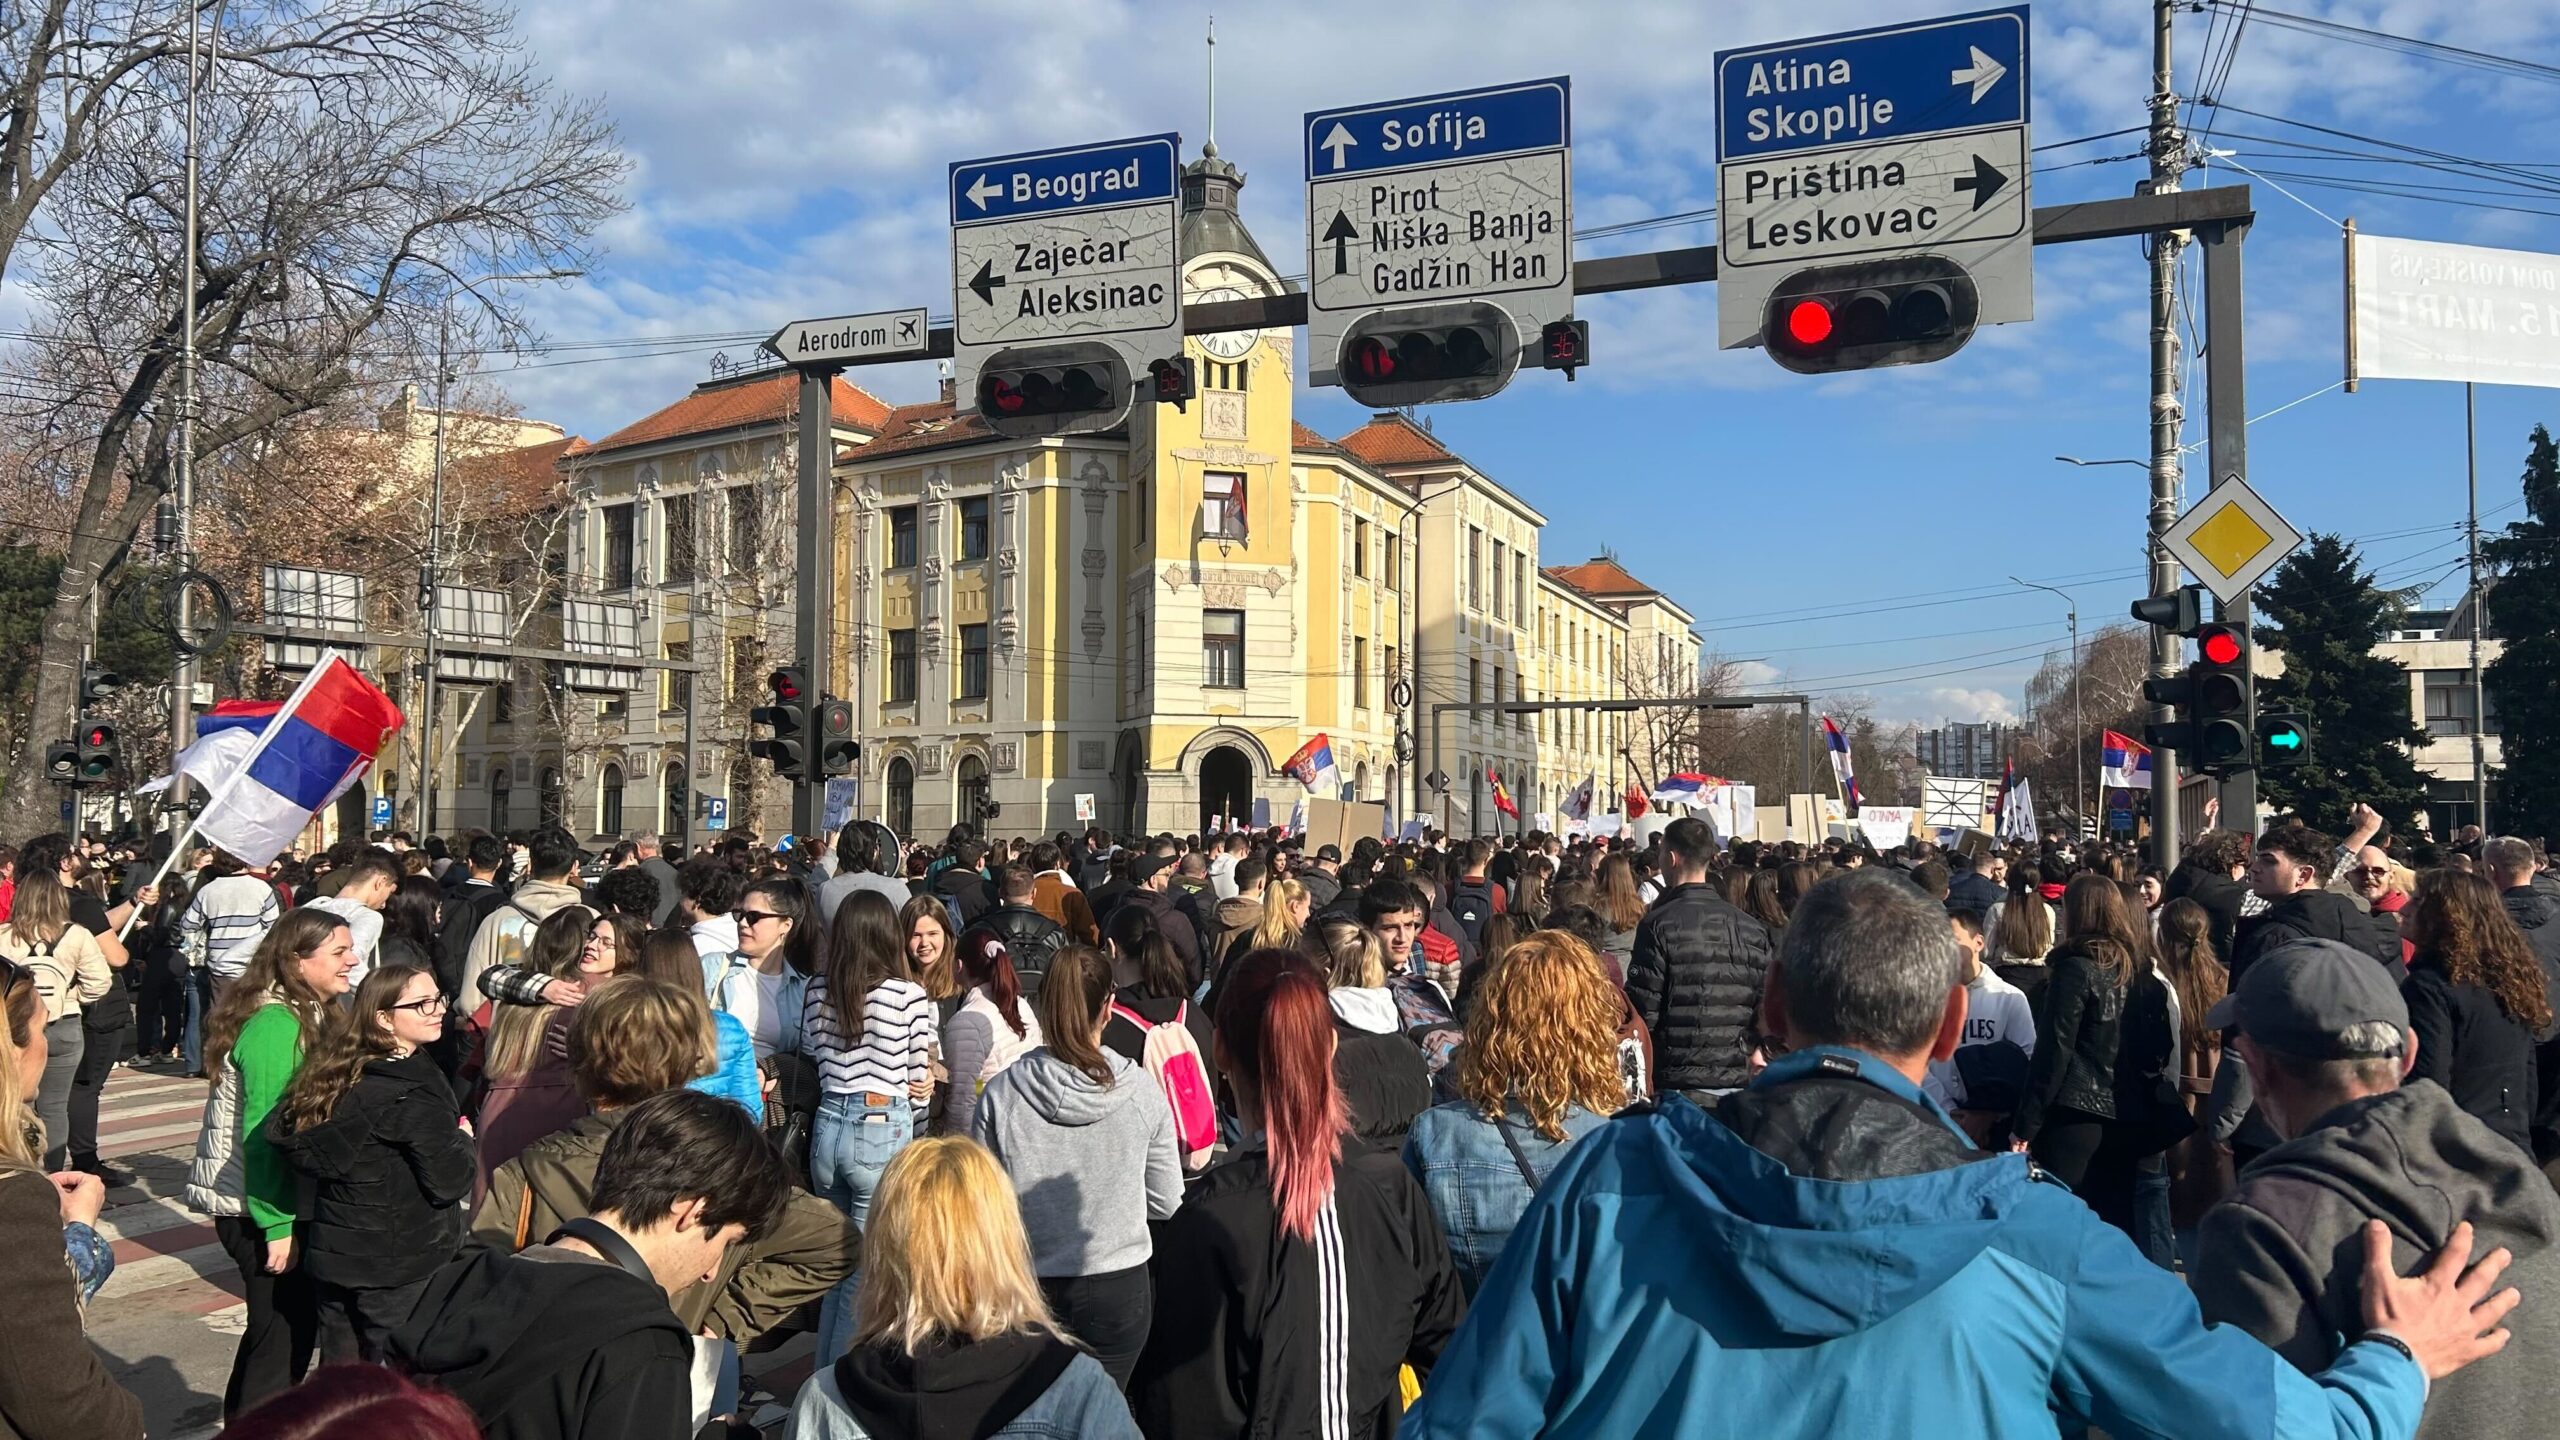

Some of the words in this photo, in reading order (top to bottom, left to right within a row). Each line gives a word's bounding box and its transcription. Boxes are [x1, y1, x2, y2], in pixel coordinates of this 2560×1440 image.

[1746, 58, 1851, 97] Atina
[1382, 111, 1486, 152] Sofija
[1746, 94, 1894, 142] Skoplje
[1012, 158, 1139, 203] Beograd
[1371, 179, 1440, 217] Pirot
[1745, 159, 1906, 204] Priština
[1372, 216, 1449, 253] Niška
[1469, 205, 1552, 244] Banja
[1747, 206, 1938, 250] Leskovac
[1014, 237, 1130, 277] Zaječar
[1373, 256, 1471, 294] Gadžin
[1491, 249, 1546, 283] Han
[1017, 282, 1164, 318] Aleksinac
[797, 325, 887, 353] Aerodrom
[376, 800, 388, 814] P
[712, 800, 724, 817] P
